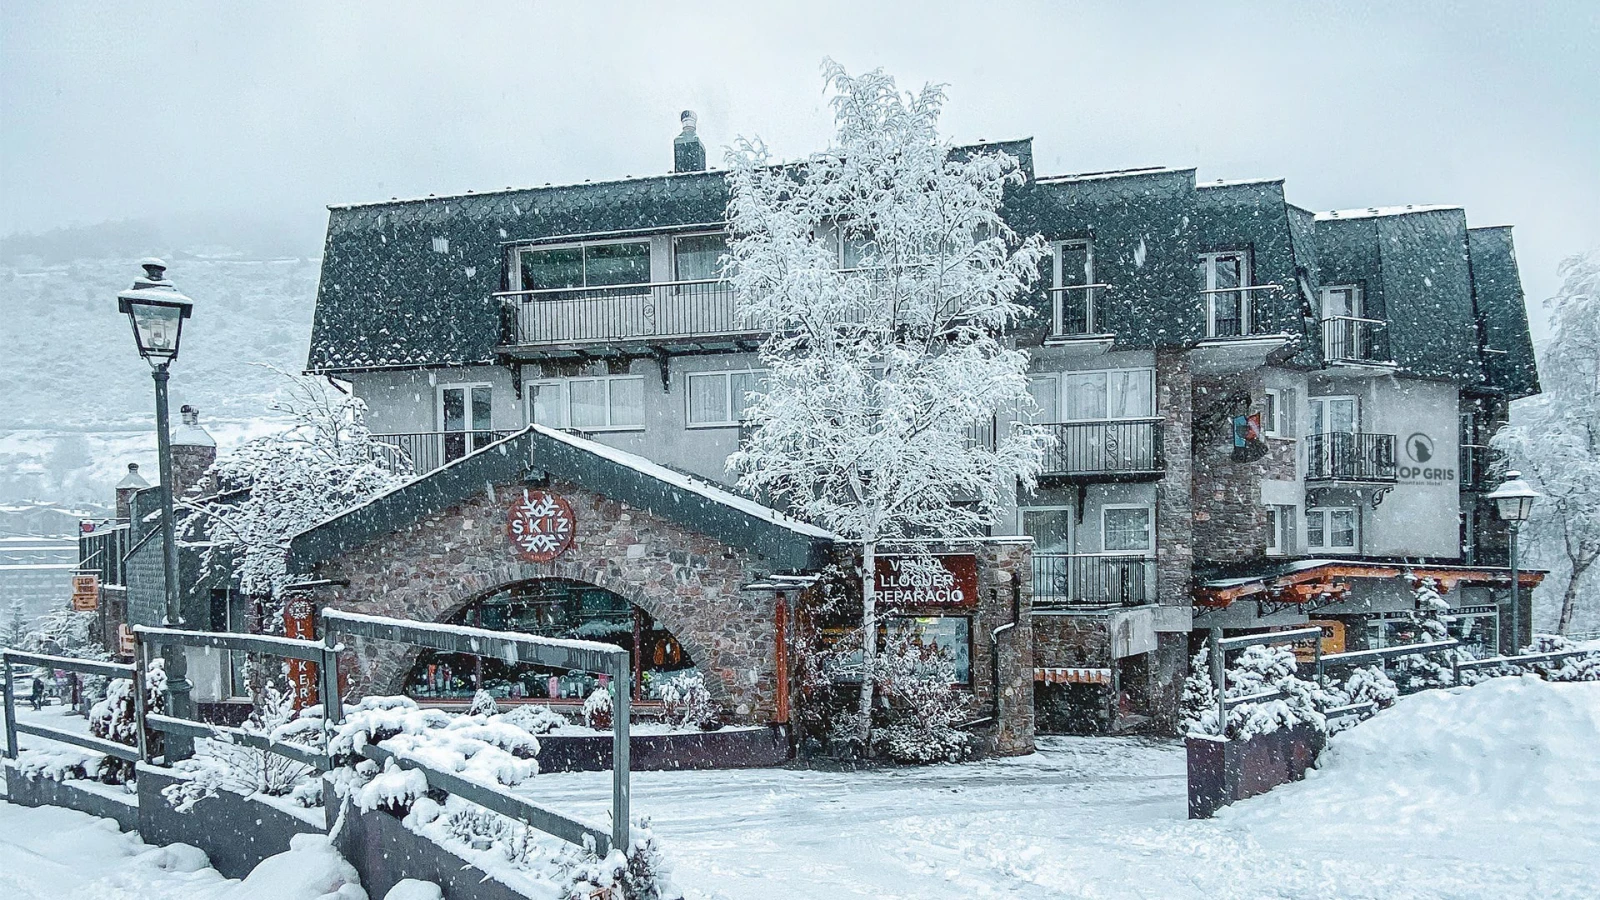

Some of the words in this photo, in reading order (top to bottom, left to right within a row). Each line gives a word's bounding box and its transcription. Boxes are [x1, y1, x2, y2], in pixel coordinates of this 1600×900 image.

[1396, 467, 1421, 479] OP
[1423, 468, 1455, 481] GRIS
[512, 518, 569, 534] SKIZ
[880, 574, 954, 588] LLOGUER
[874, 586, 965, 603] REPARACIÓ
